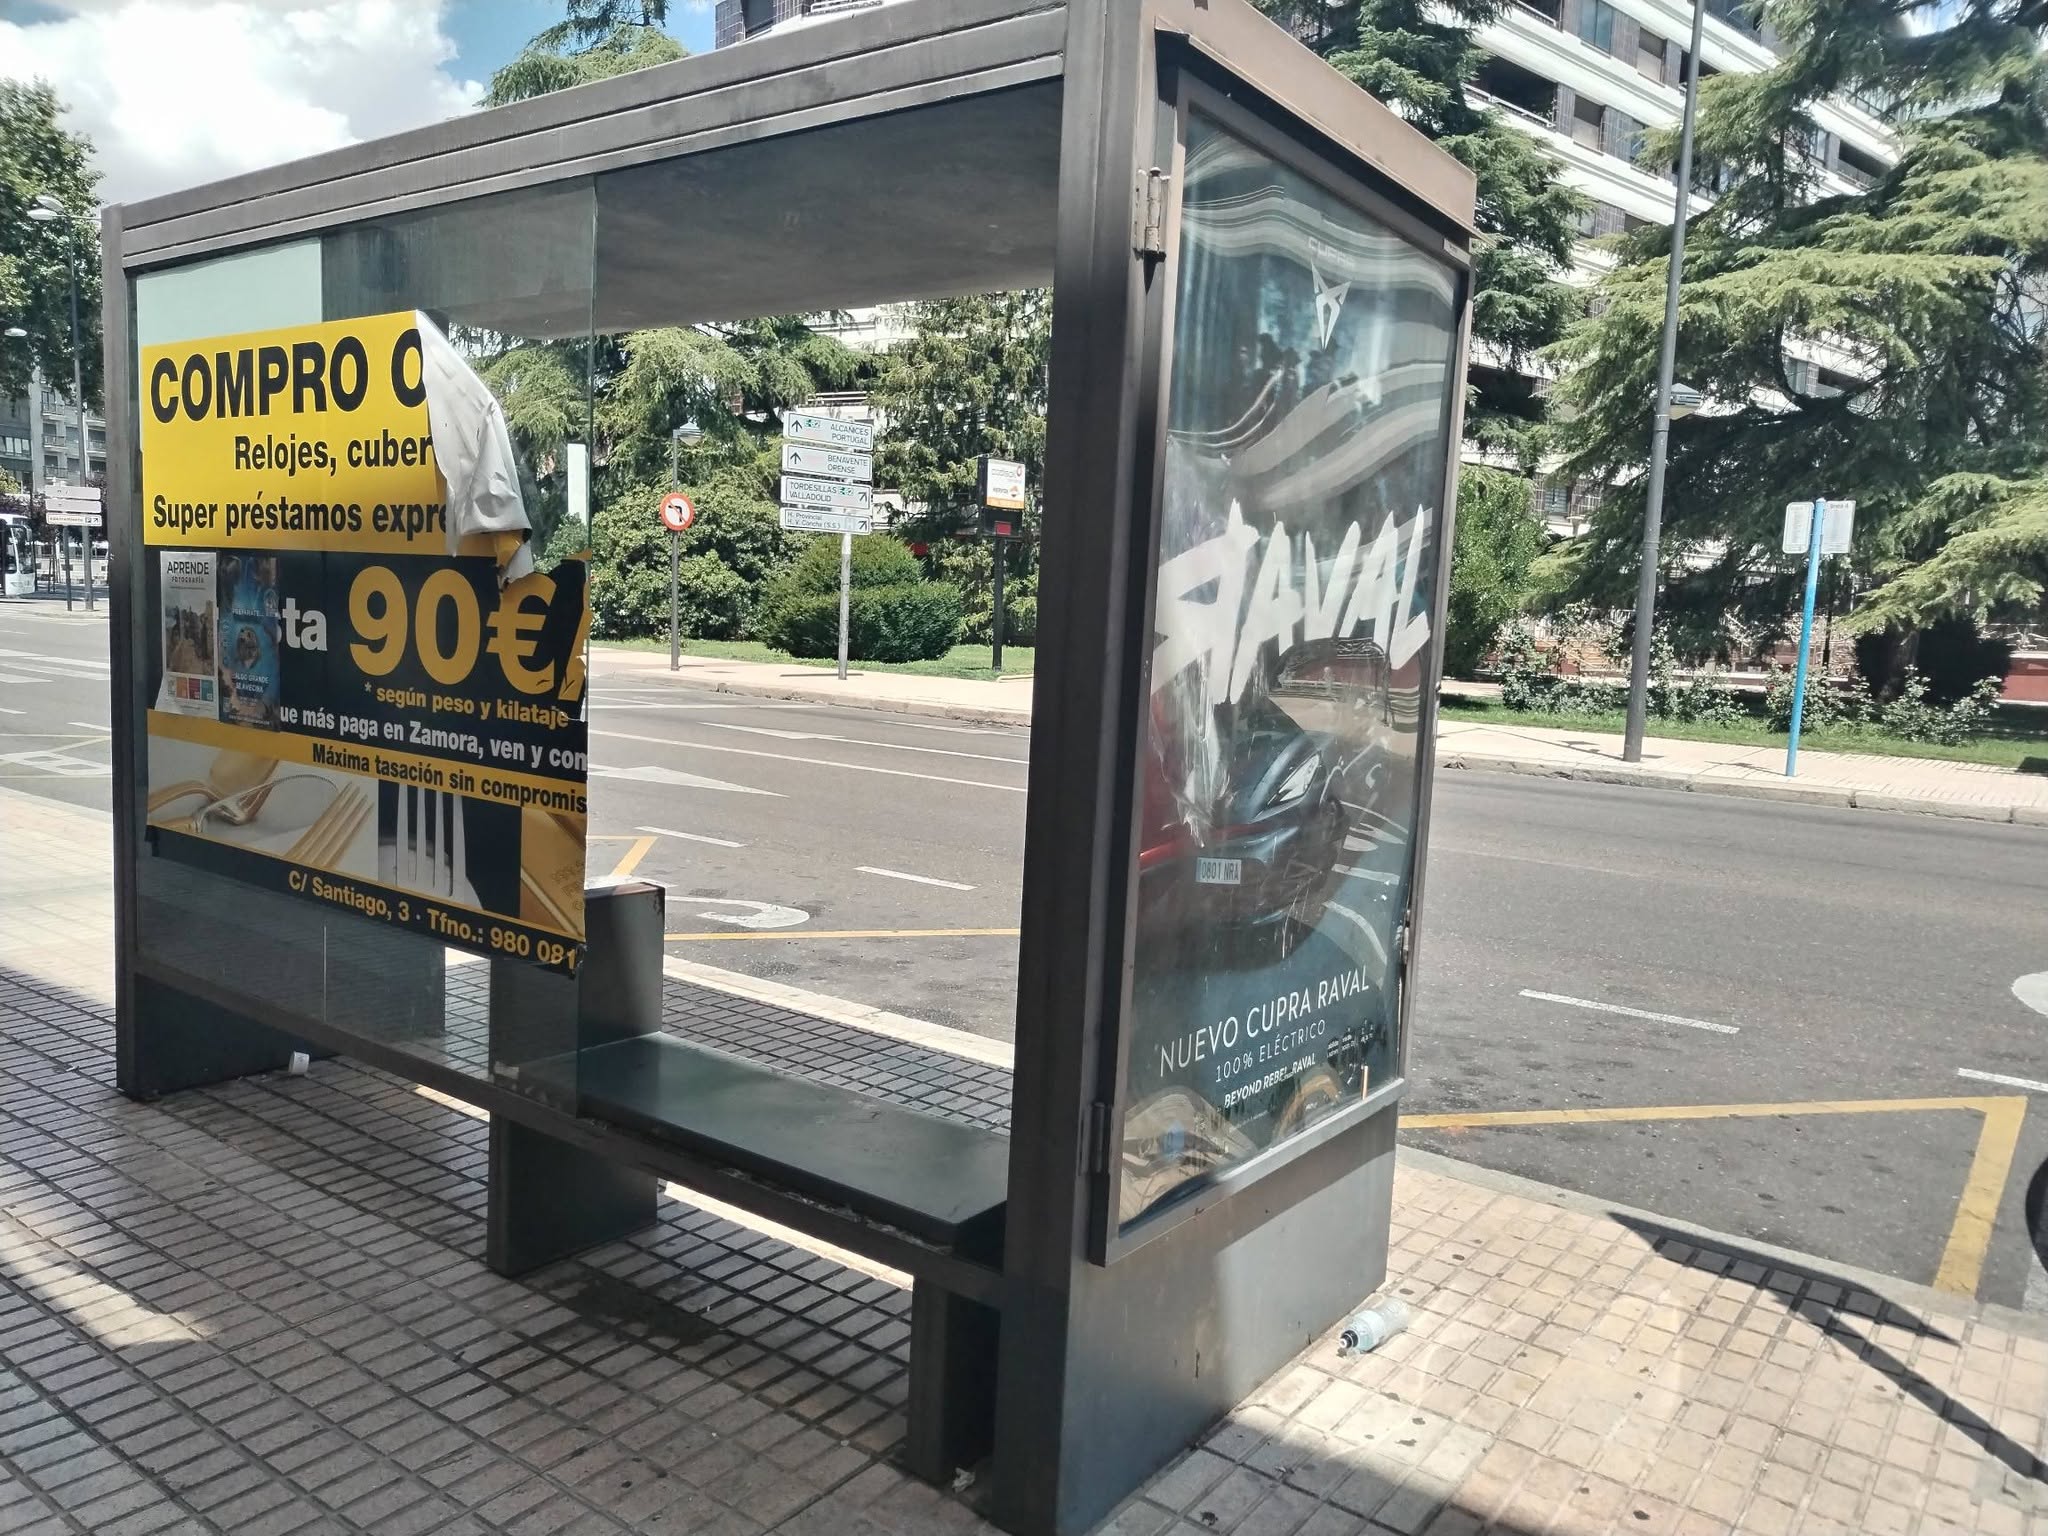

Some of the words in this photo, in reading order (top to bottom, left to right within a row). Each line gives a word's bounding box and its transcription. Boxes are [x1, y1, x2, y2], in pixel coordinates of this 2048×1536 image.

[151, 336, 369, 424] COMPRO
[391, 328, 427, 408] O
[234, 433, 337, 477] Relojes,
[347, 429, 434, 468] cuber
[827, 455, 868, 467] BENAVENTE
[832, 433, 869, 445] PORTUGAL
[790, 481, 837, 494] TORDESILLAS
[827, 464, 855, 474] ORENSE
[153, 494, 218, 535] Super
[225, 490, 362, 536] préstamos
[789, 491, 832, 502] VALLADOLID
[167, 561, 209, 575] APRENDE
[277, 597, 328, 651] ta
[376, 686, 427, 708] según
[432, 694, 475, 714] peso
[480, 702, 492, 719] y
[497, 699, 569, 730] kilataje
[302, 706, 335, 730] más
[340, 715, 379, 741] paga
[383, 723, 404, 740] en
[409, 721, 484, 760] Zamora,
[489, 738, 525, 761] ven
[530, 745, 544, 769] y
[312, 742, 370, 774] Máxima
[374, 752, 444, 788] tasación
[448, 769, 475, 793] sin
[481, 778, 587, 814] compromis
[288, 870, 306, 893] C/
[312, 874, 393, 921] Santiago,
[398, 901, 411, 921] 3
[427, 907, 484, 944] Tfno.:
[489, 926, 530, 957] 980
[536, 939, 577, 970] 081
[1159, 1017, 1239, 1077] NUEVO
[1246, 988, 1312, 1038] CUPRA
[1317, 965, 1370, 1010] RAVAL
[1215, 1051, 1253, 1083] 100%
[1259, 1019, 1327, 1063] ELÉCTRICO
[1224, 1080, 1262, 1109] BEYOND
[1292, 1053, 1316, 1075] RAVAL
